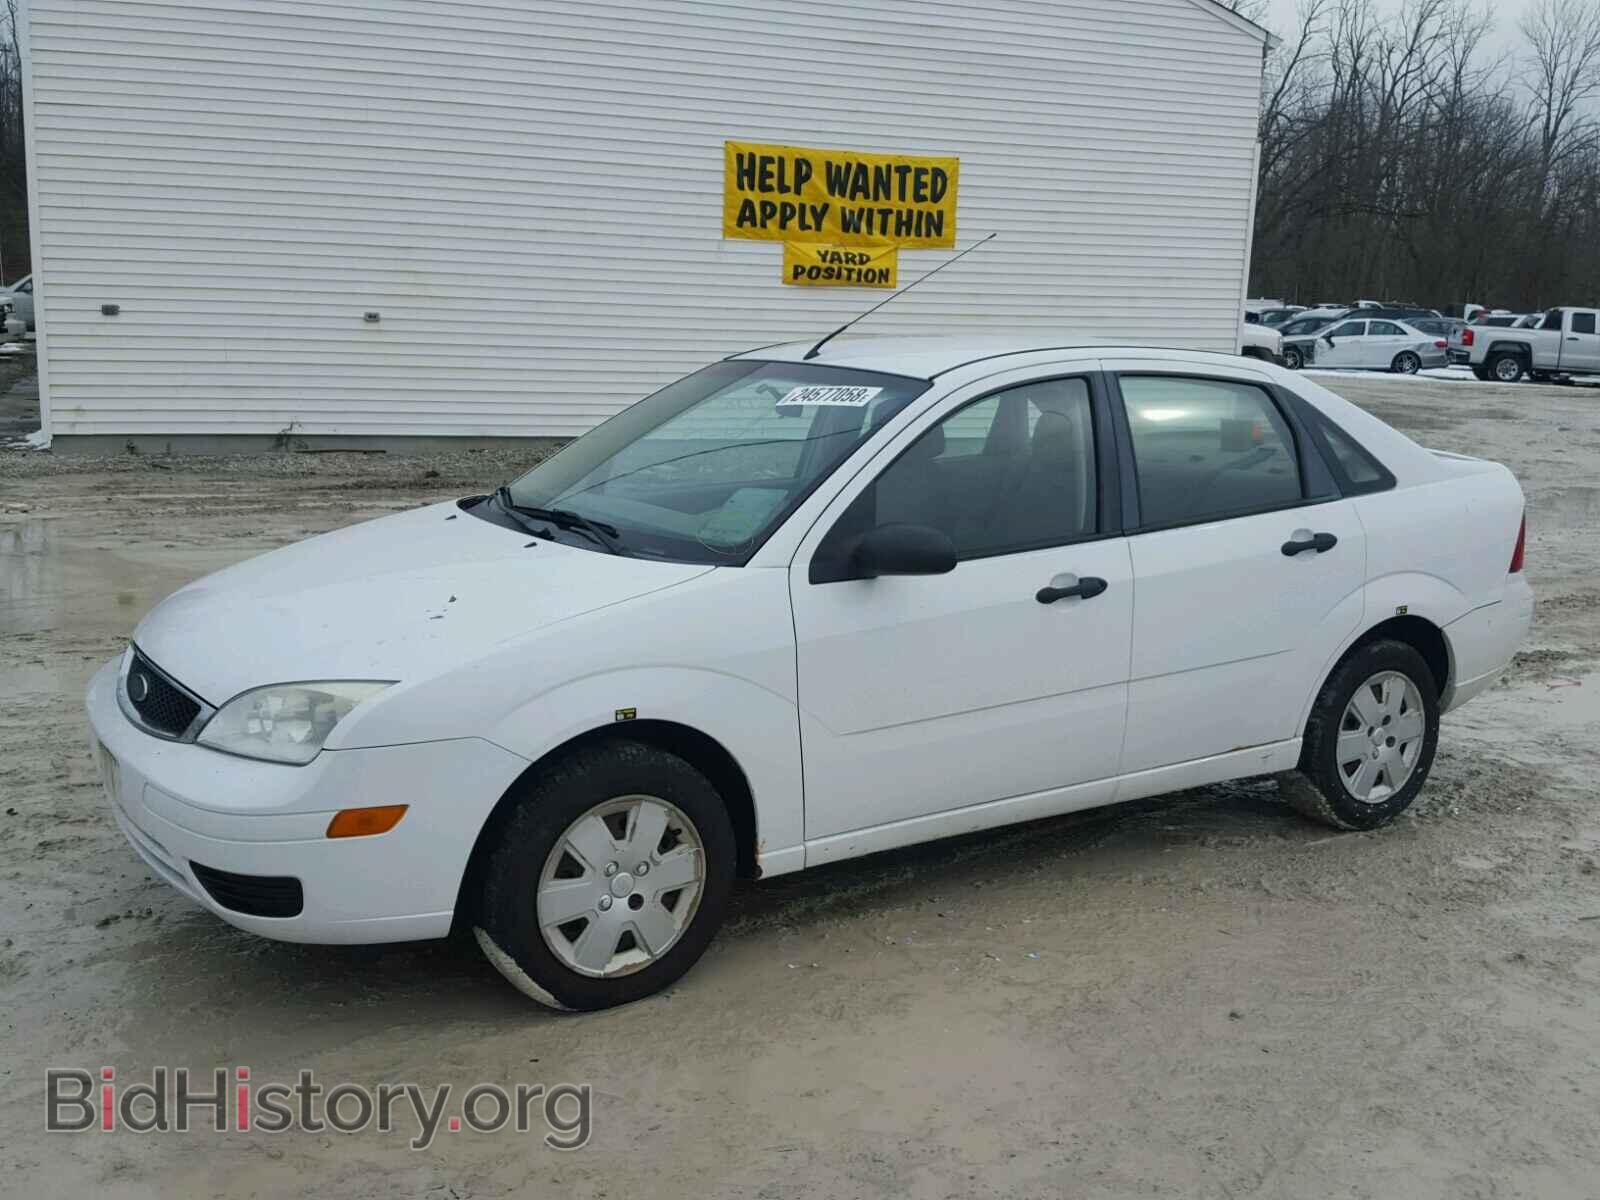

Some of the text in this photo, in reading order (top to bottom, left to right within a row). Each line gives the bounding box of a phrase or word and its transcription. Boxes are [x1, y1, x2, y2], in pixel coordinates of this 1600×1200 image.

[736, 152, 948, 204] HELP WANTED
[736, 198, 944, 238] APPLY WITHIN
[816, 249, 871, 265] YARD
[792, 265, 890, 284] POSITION
